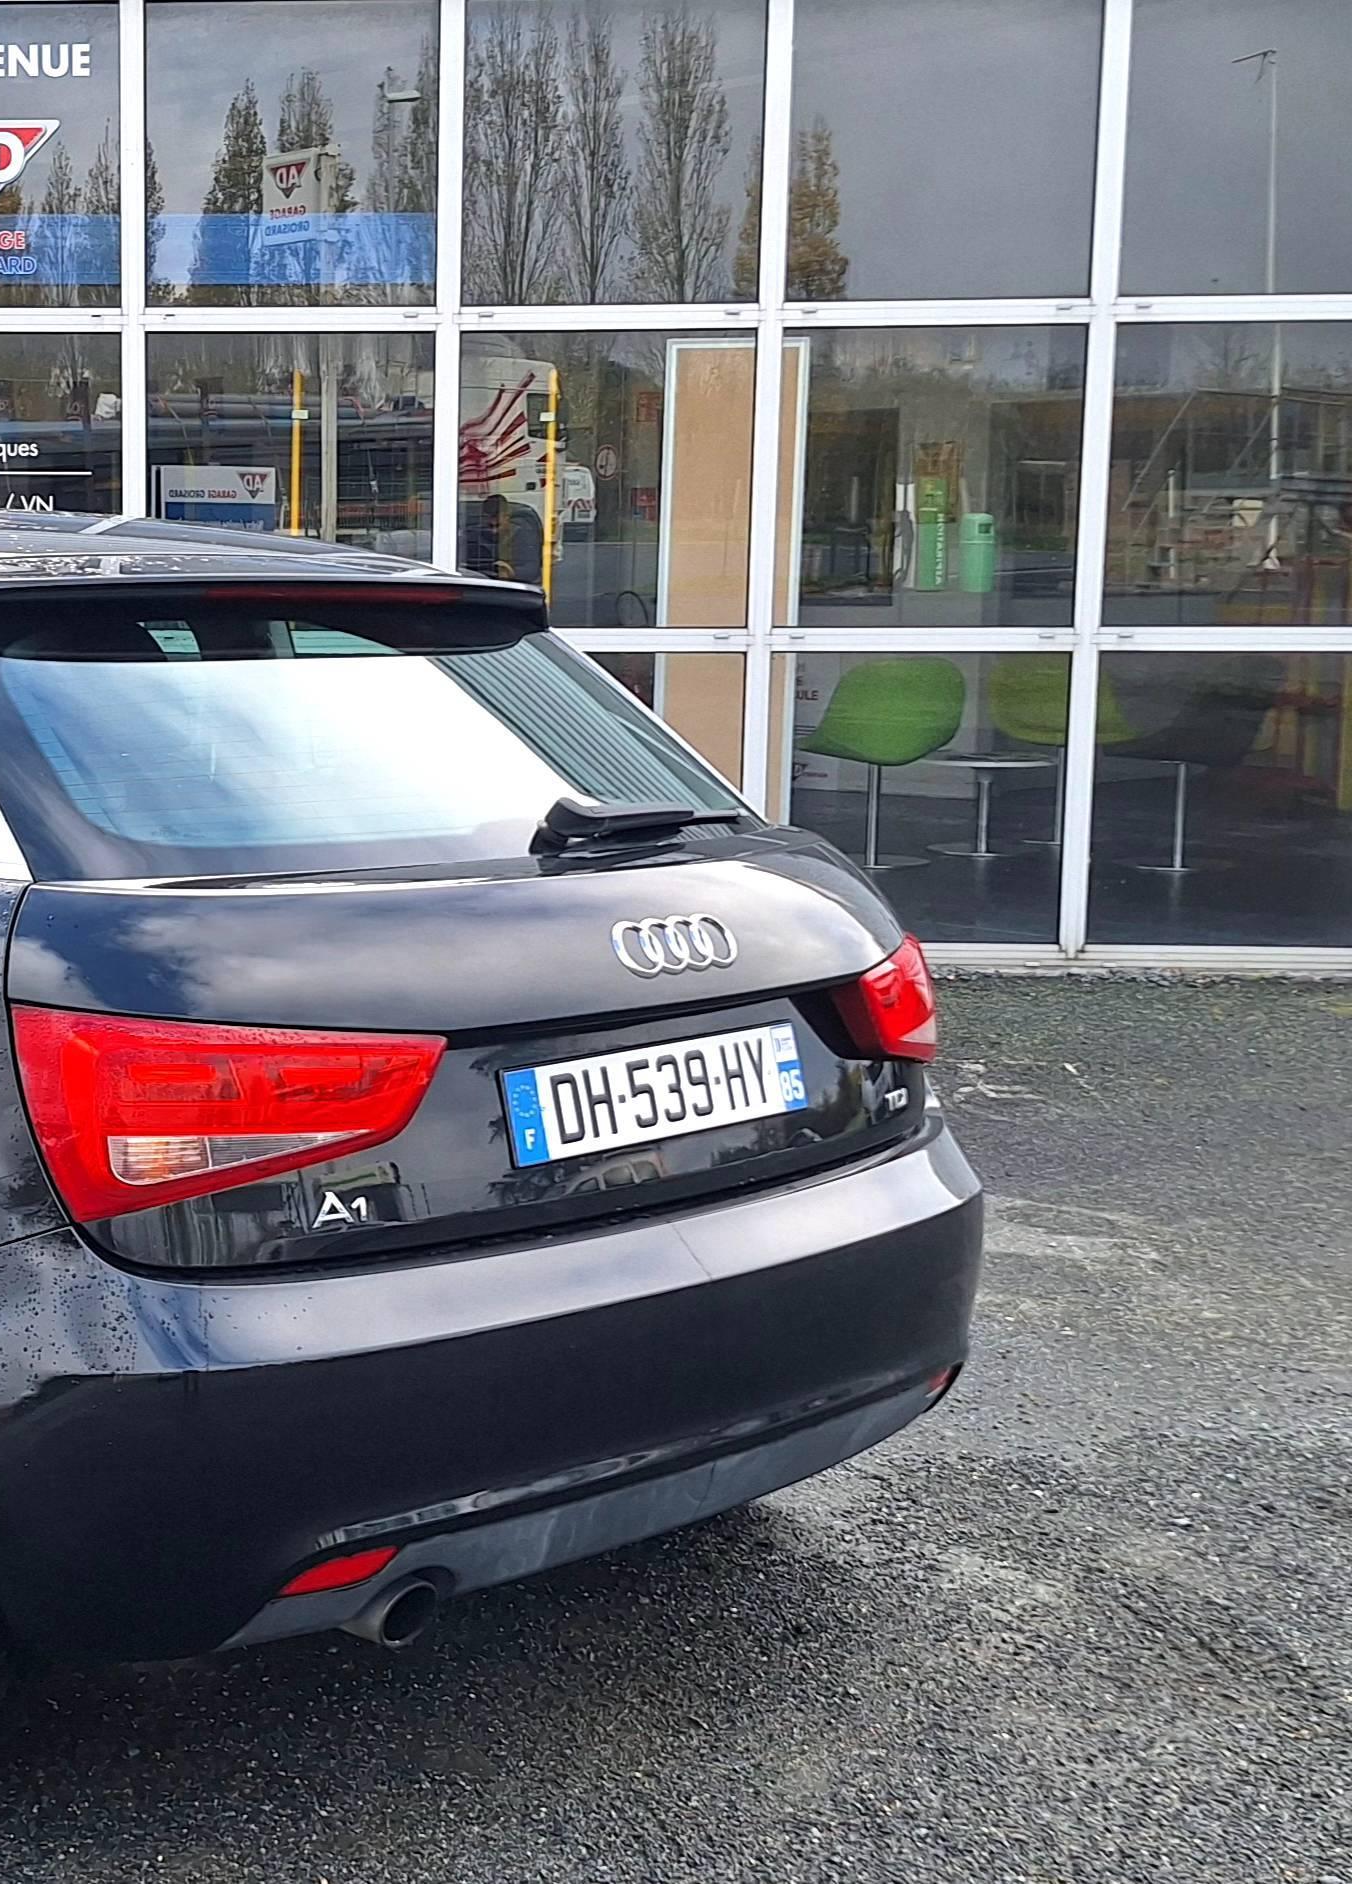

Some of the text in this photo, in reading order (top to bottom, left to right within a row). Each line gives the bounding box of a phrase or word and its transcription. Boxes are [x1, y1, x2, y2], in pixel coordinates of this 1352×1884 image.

[796, 690, 819, 701] ULE
[780, 1068, 805, 1102] 85
[523, 1128, 536, 1151] F
[311, 1191, 368, 1229] A1
